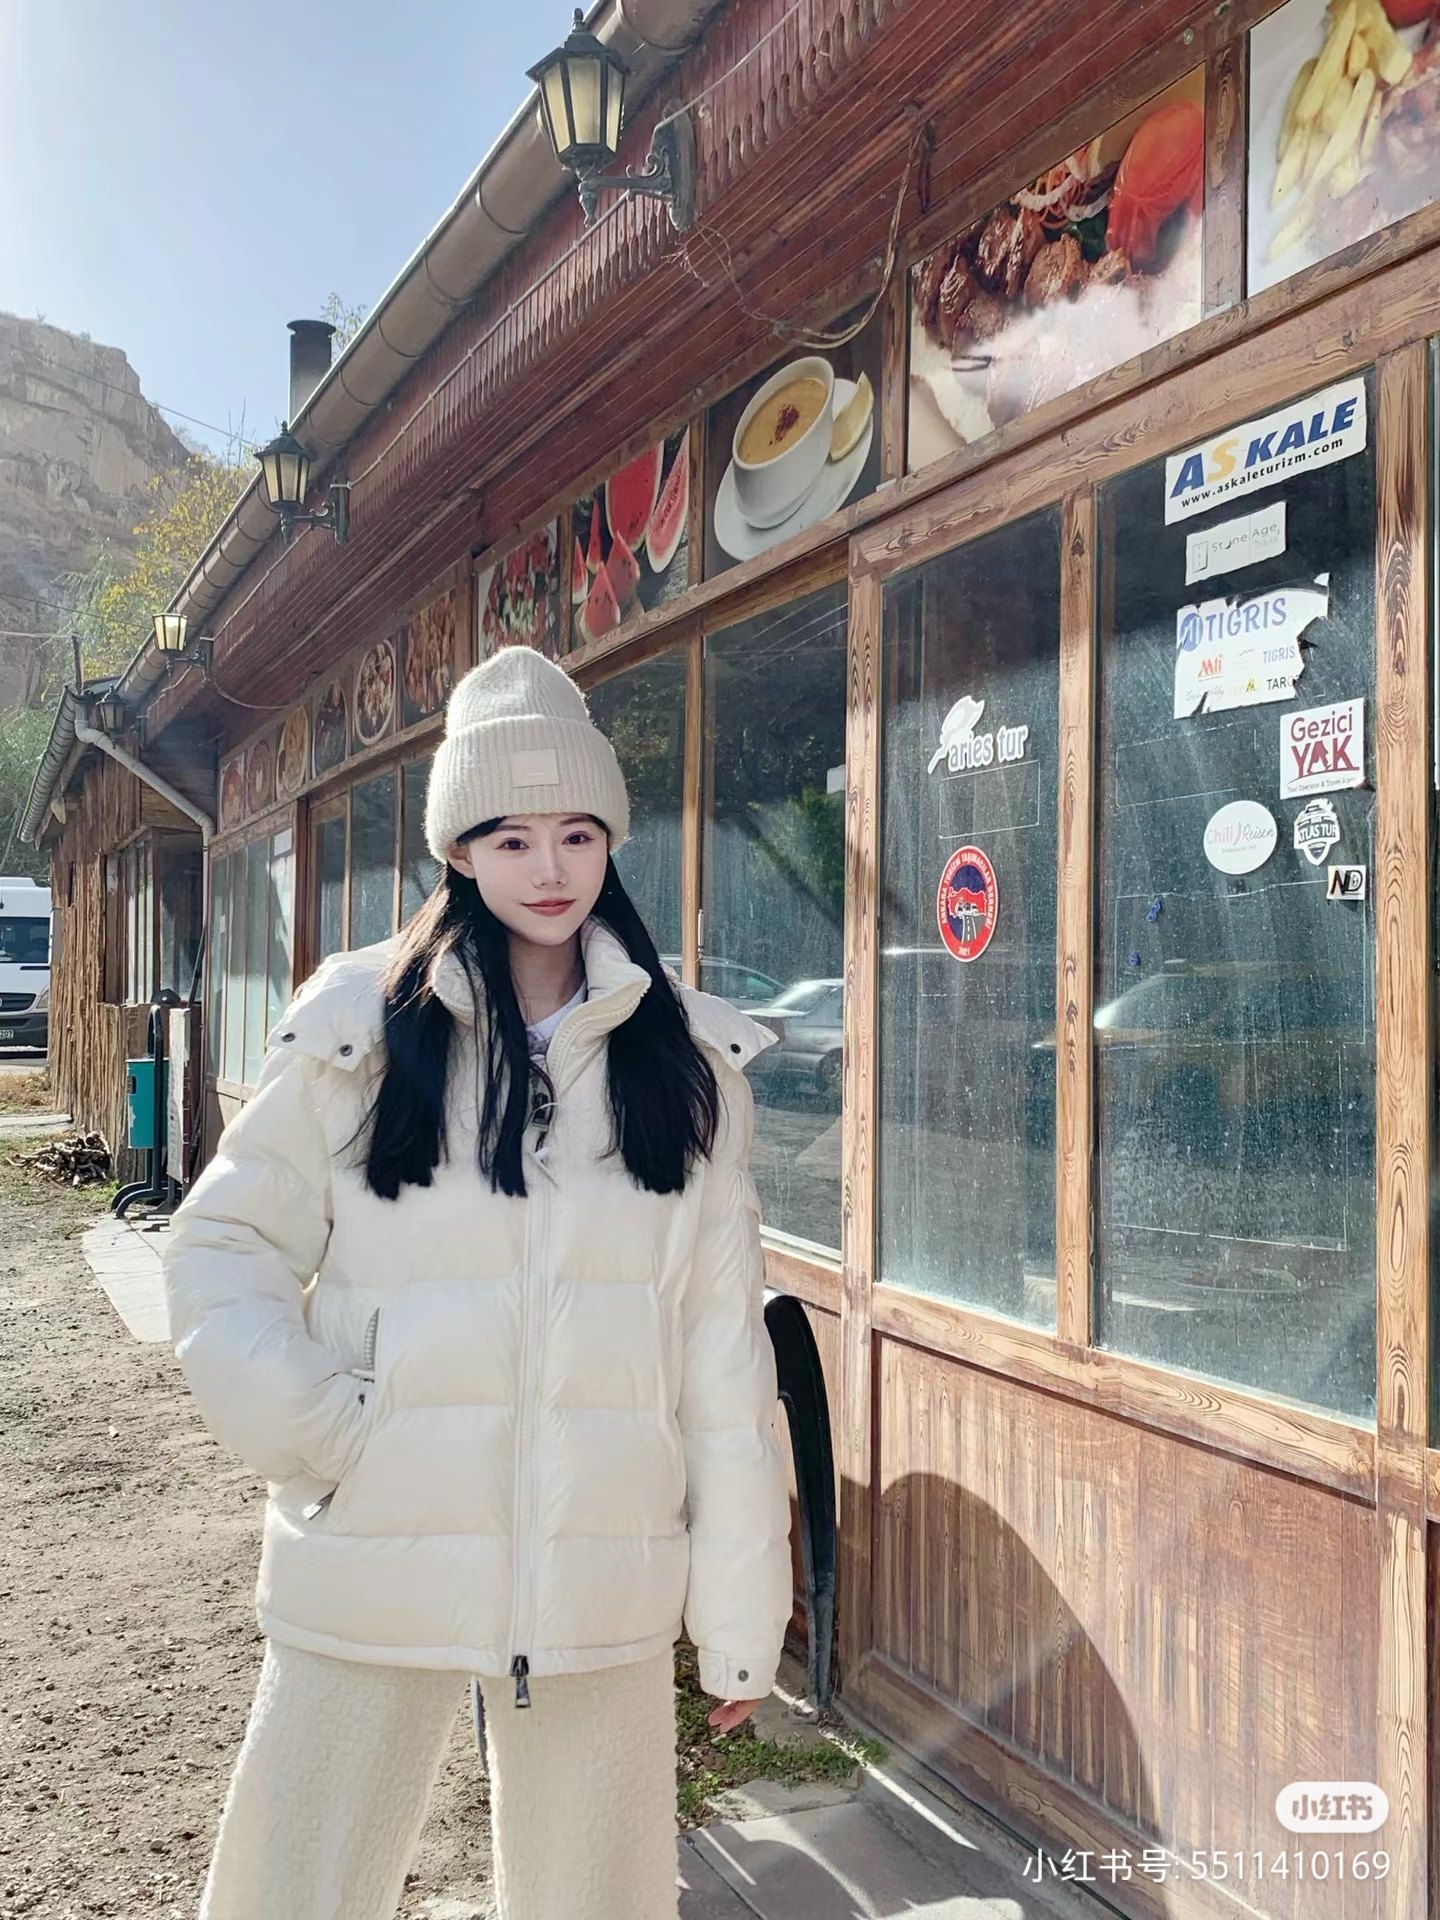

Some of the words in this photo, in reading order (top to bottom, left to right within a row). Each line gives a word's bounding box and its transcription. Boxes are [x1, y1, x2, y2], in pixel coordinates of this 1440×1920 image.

[1170, 397, 1357, 499] ASKALE
[1181, 437, 1343, 508] www.askaleturizm.com
[1252, 523, 1278, 539] Age
[1205, 597, 1287, 642] TIGRIS
[1263, 645, 1296, 664] TIGRIS
[1290, 706, 1353, 742] Gezici
[949, 735, 993, 770] aries
[998, 726, 1028, 759] tur
[1291, 735, 1360, 778] YAK
